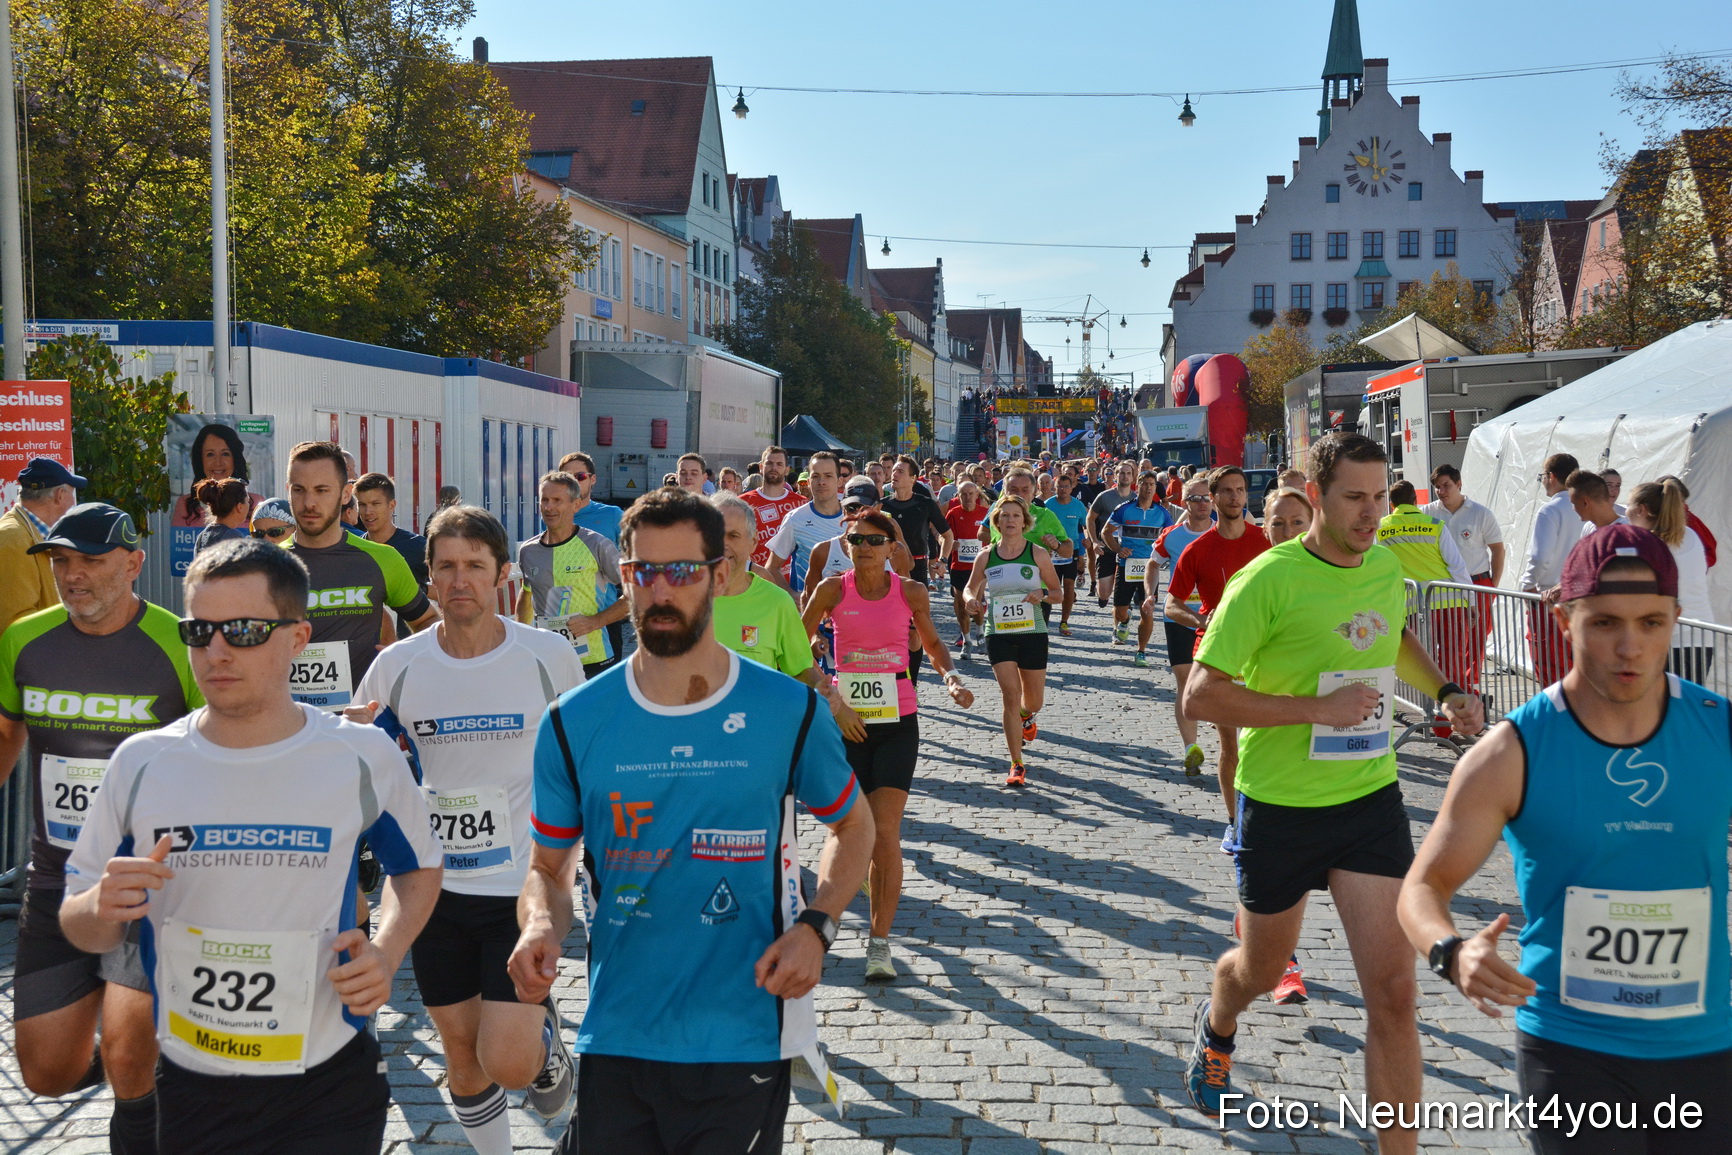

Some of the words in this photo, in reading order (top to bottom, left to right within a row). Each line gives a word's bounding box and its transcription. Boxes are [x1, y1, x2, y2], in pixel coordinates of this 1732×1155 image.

[50, 326, 65, 334] DIXI
[1028, 401, 1062, 410] START
[18, 441, 48, 450] Lehrer
[50, 440, 62, 450] für
[175, 530, 197, 544] Hel
[1380, 525, 1433, 538] Org.-Leiter
[961, 545, 979, 554] 2335
[175, 560, 190, 571] CS
[313, 610, 338, 618] smart
[340, 608, 373, 616] concepts
[1002, 604, 1024, 617] 215
[300, 649, 326, 657] OCK
[289, 661, 339, 684] 2524
[850, 681, 884, 699] 206
[23, 687, 158, 723] BOCK
[300, 694, 328, 705] Marco
[859, 710, 882, 719] mgard
[54, 721, 69, 731] by
[72, 722, 106, 732] smart
[443, 716, 520, 732] BÜSCHEL
[1347, 738, 1370, 750] Götz
[437, 795, 479, 808] BOCK
[430, 809, 496, 841] 2784
[203, 828, 325, 848] BÜSCHEL
[711, 835, 766, 848] CARRERA
[443, 844, 454, 852] RTL
[455, 843, 484, 851] Neumarkt
[161, 853, 328, 869] INSCHNEIDTEAM
[450, 855, 480, 868] Peter
[1609, 902, 1673, 917] BOCK
[201, 940, 273, 960] BOCK
[1585, 926, 1689, 966] 2077
[1593, 967, 1625, 978] PARTL
[1627, 969, 1669, 980] Neumarkt
[191, 966, 277, 1012] 232
[1612, 987, 1662, 1005] Josef
[188, 1008, 216, 1025] PARTL
[217, 1017, 264, 1029] Neumarkt
[195, 1029, 263, 1057] Markus
